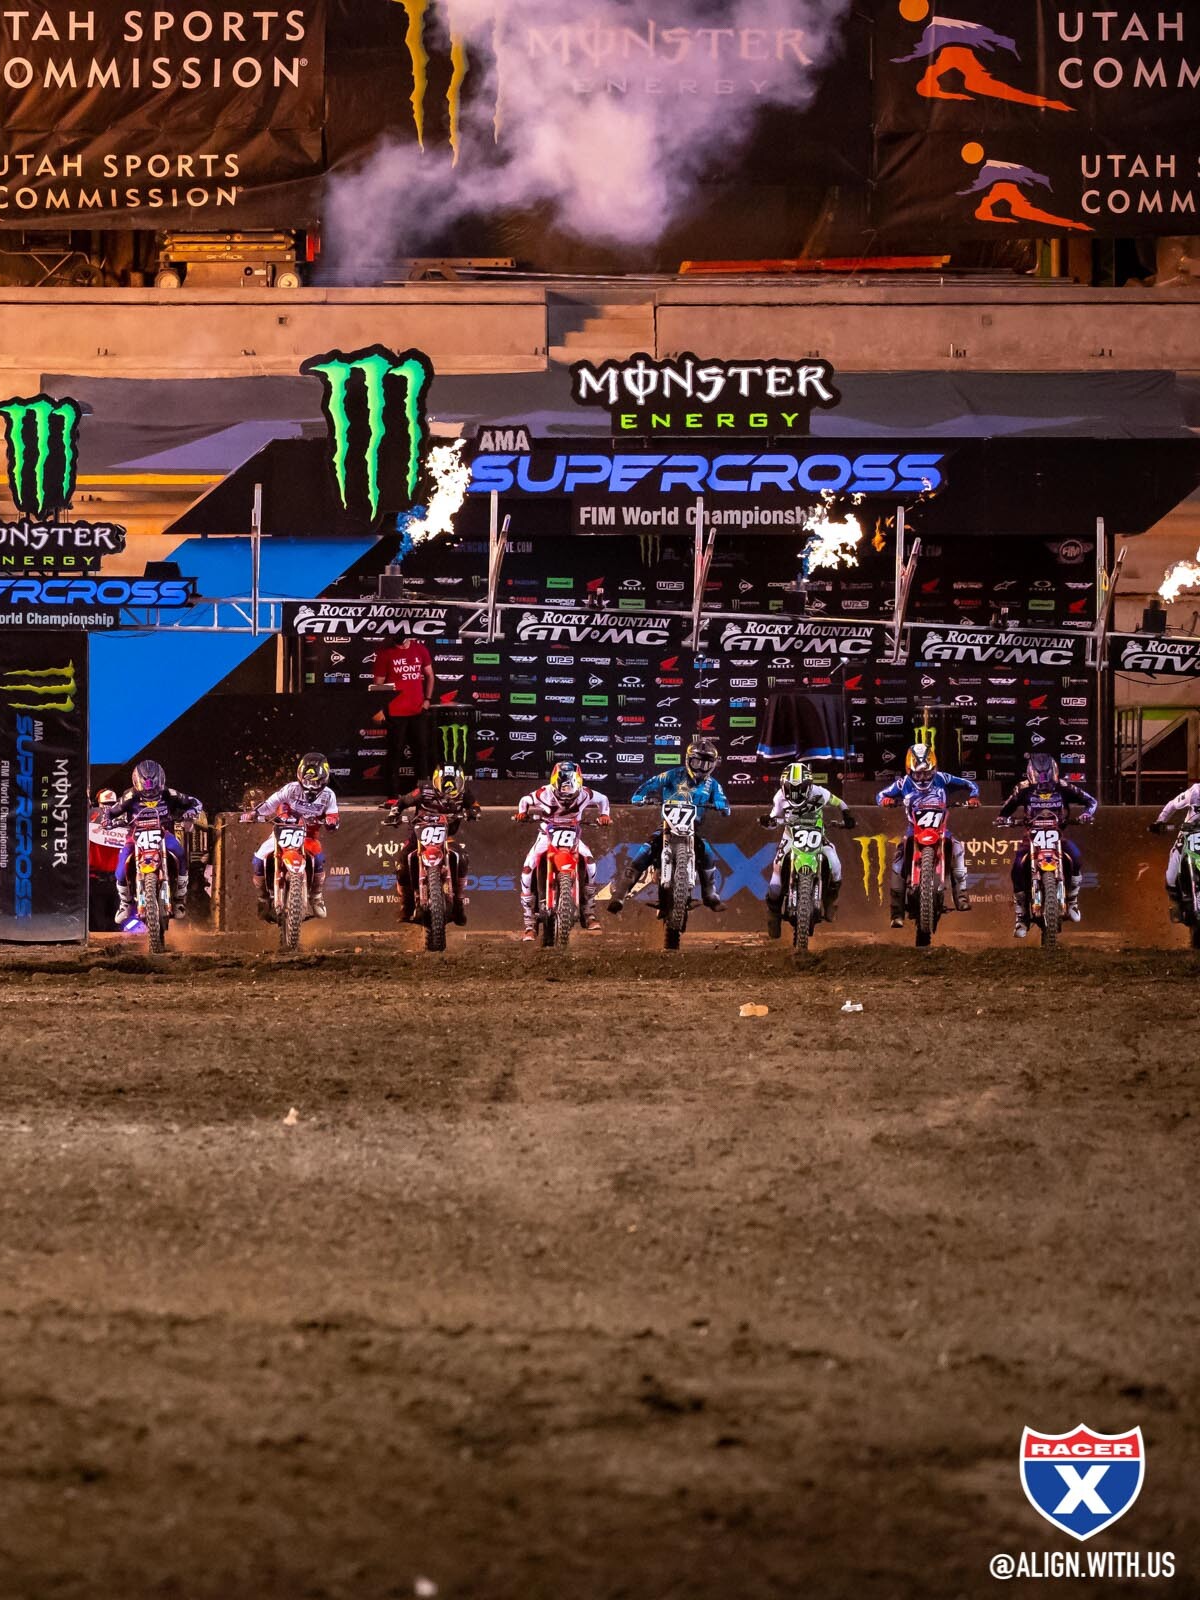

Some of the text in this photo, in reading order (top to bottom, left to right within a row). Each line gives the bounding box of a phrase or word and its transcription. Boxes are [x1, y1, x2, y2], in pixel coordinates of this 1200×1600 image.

[124, 10, 306, 42] SPORTS
[1058, 12, 1184, 42] UTAH
[527, 20, 814, 67] MONSTER
[572, 78, 770, 96] ENERGY
[103, 153, 239, 178] SPORTS
[1081, 154, 1175, 178] UTAH
[1081, 190, 1196, 214] COMM
[578, 360, 834, 405] MONSTER
[620, 412, 799, 429] ENERGY
[479, 430, 530, 451] AMA
[467, 454, 945, 492] SUPERCROSS
[580, 506, 616, 526] FIM
[622, 506, 679, 526] World
[26, 611, 115, 628] Championship
[317, 604, 448, 619] ROCKY MOUNTAIN
[541, 611, 671, 629] ROCKY MOUNTAIN
[744, 621, 874, 638] ROCKY MOUNTAIN
[945, 630, 1076, 649] ROCKY MOUNTAIN
[1145, 640, 1195, 655] ROCKY
[393, 658, 408, 666] WE
[394, 664, 421, 673] WON'T
[33, 719, 43, 742] AMA
[0, 760, 10, 868] FIM World Championship
[15, 713, 34, 919] SUPERCROSS
[51, 758, 72, 868] MONSTER
[667, 808, 693, 826] 47
[917, 811, 943, 827] 41
[137, 829, 162, 849] 45
[279, 829, 305, 848] 56
[421, 826, 446, 846] 95
[551, 831, 576, 847] 18
[794, 830, 822, 848] 30
[1033, 830, 1059, 849] 42
[330, 867, 350, 875] AMA
[369, 896, 384, 904] FIM
